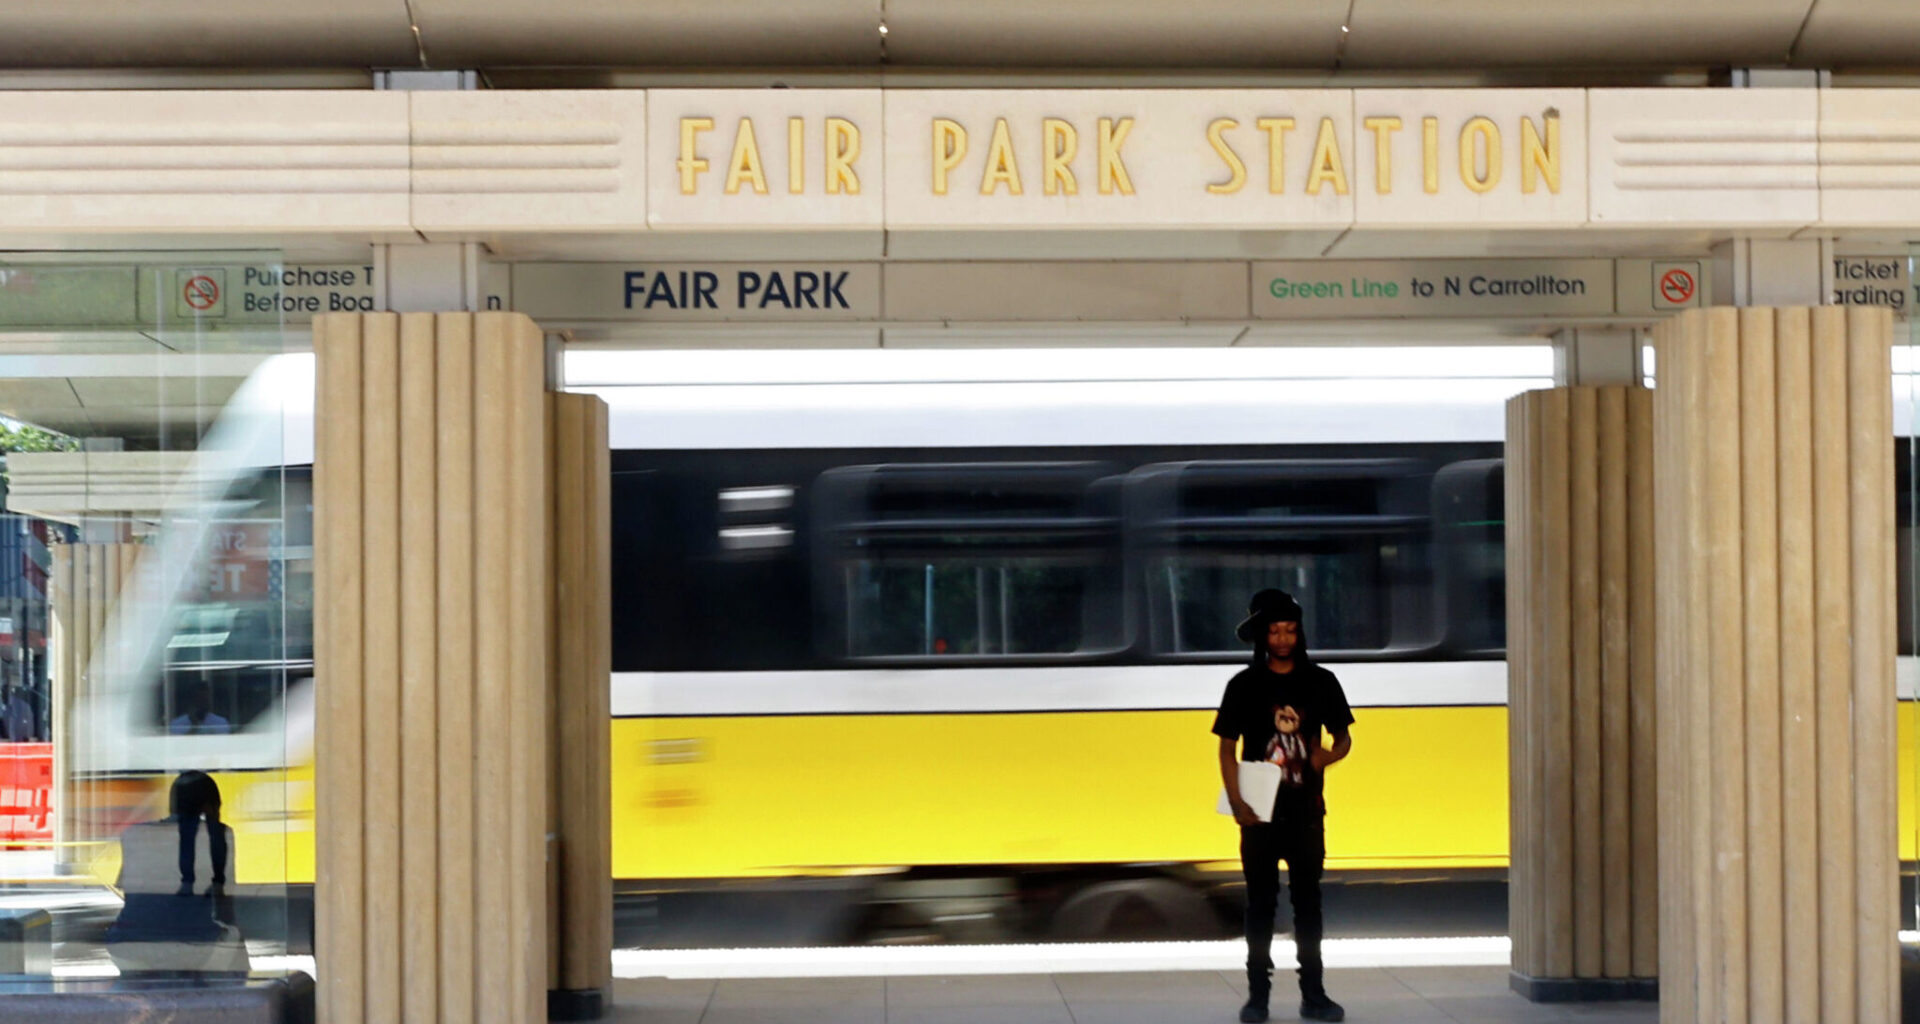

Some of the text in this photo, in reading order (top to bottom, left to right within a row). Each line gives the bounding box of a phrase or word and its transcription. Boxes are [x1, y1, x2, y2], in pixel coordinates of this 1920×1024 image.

[676, 115, 1561, 195] FAIR PARK STATION
[244, 266, 355, 286] Purchase
[1833, 258, 1899, 279] Ticket
[624, 271, 850, 309] FAIR PARK
[1269, 275, 1585, 298] Green Line to N Carrollton
[244, 292, 320, 312] Before
